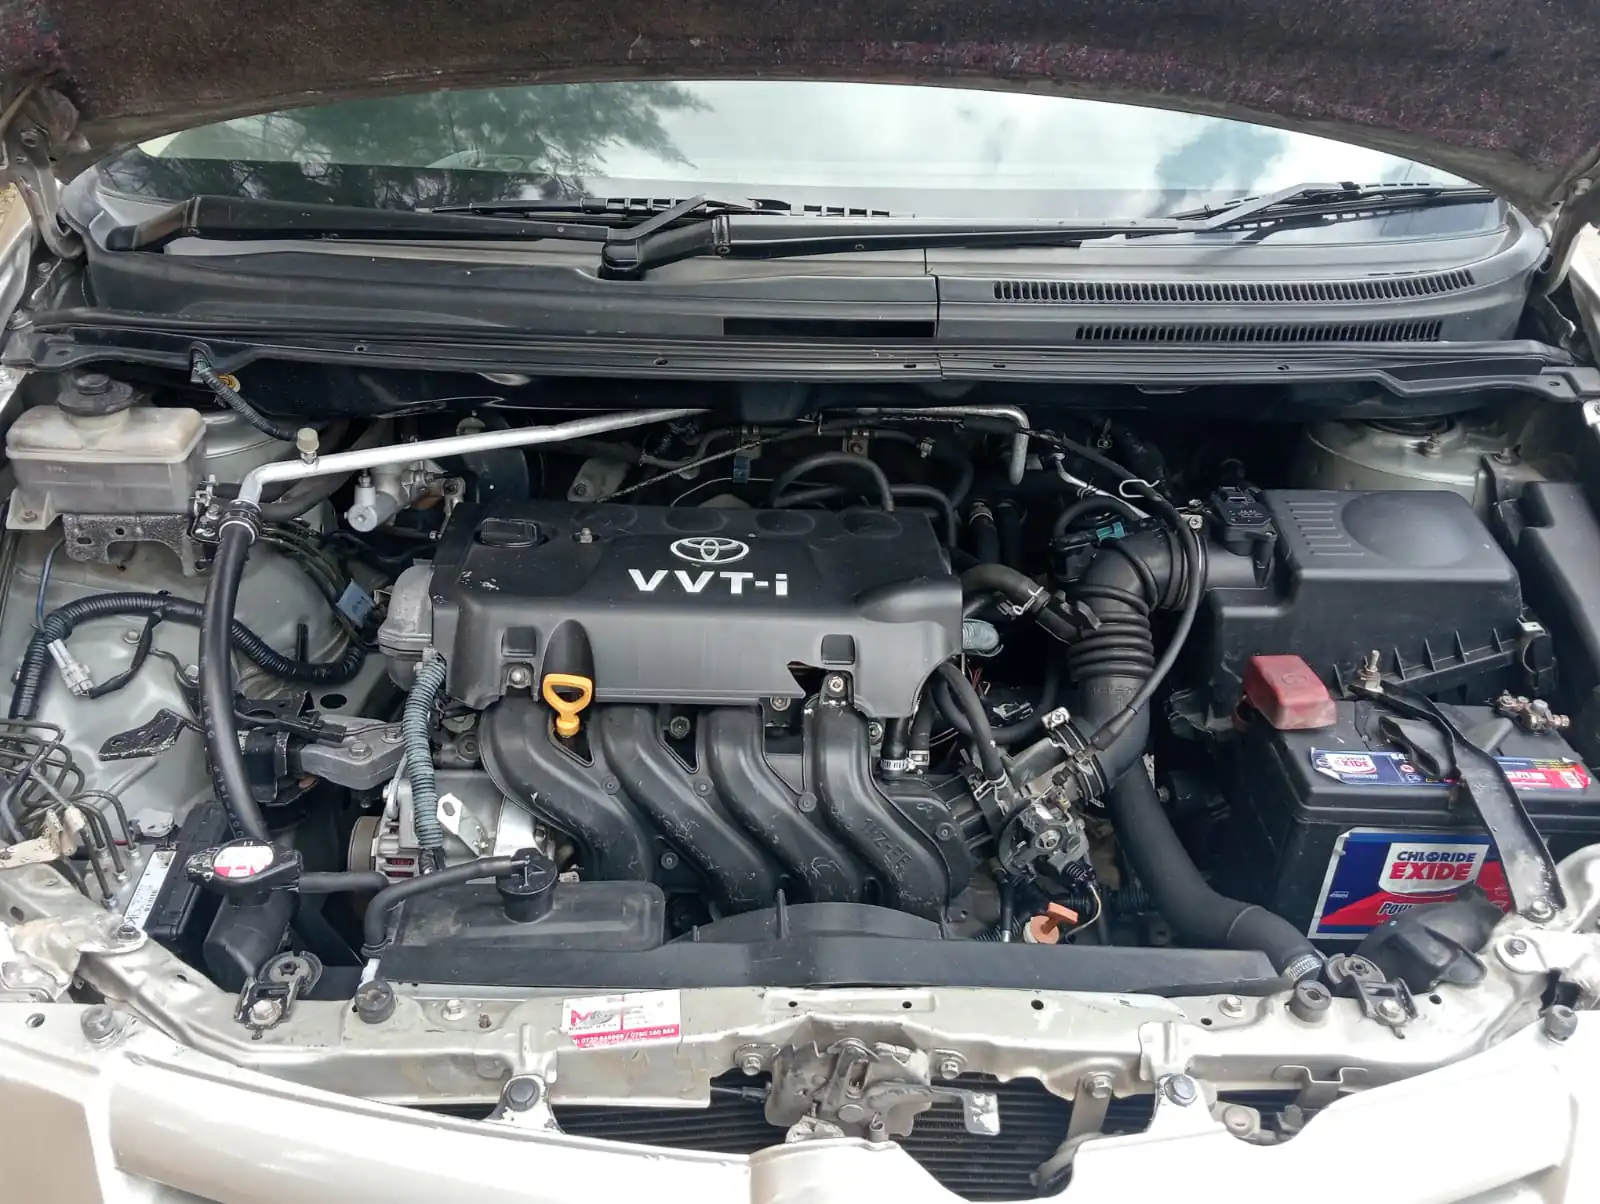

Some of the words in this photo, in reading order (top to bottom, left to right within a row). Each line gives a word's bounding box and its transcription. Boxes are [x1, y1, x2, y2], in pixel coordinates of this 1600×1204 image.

[628, 568, 788, 596] VVT-i
[1397, 851, 1477, 862] CHLORIDE
[1390, 863, 1473, 880] EXIDE
